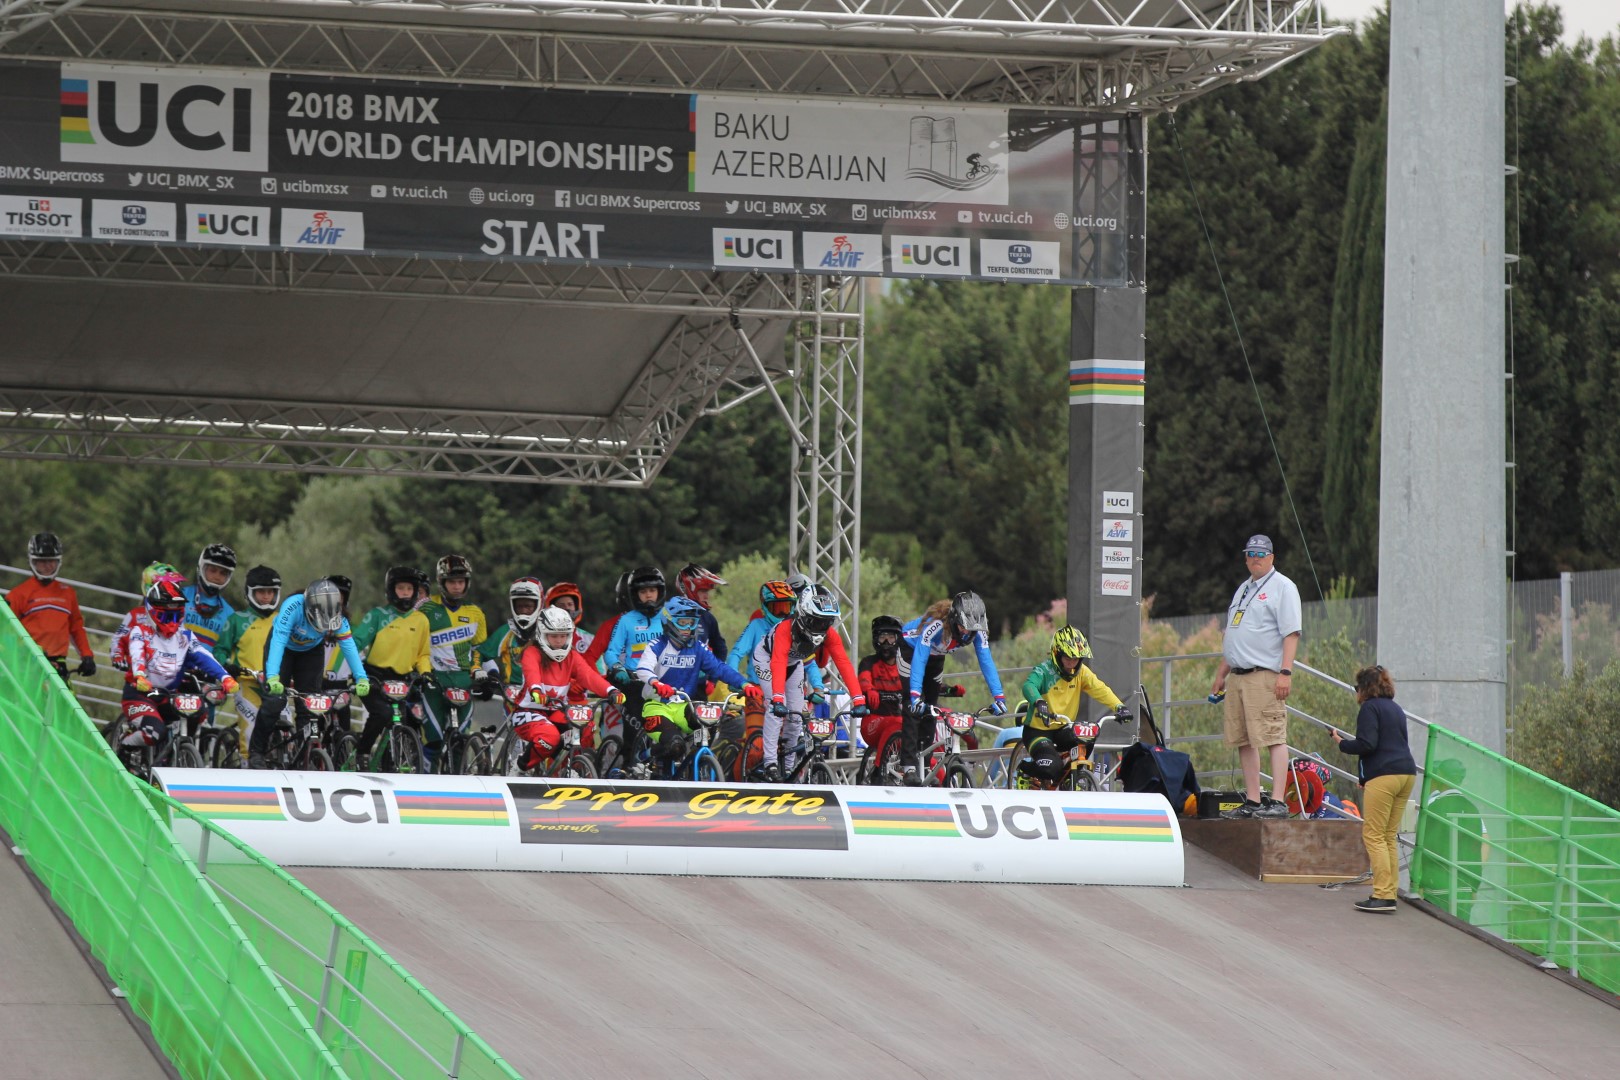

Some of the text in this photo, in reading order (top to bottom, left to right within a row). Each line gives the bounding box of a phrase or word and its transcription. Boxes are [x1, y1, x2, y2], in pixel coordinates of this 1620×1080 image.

[98, 80, 252, 152] UCI
[287, 92, 440, 124] 2018 BMX
[714, 112, 790, 141] BAKU
[286, 128, 674, 173] WORLD CHAMPIONSHIPS
[0, 166, 104, 184] BMX Supercross
[712, 150, 886, 182] AZERBAIJAN
[147, 173, 235, 191] UCI_BMX_SX
[282, 180, 349, 195] ucibmxsx
[392, 185, 448, 200] tv.uci.ch
[488, 190, 535, 207] uci.org
[575, 193, 701, 212] UCI BMX Supercross
[744, 201, 827, 218] UCI_BMX_SX
[6, 212, 72, 227] TISSOT
[873, 206, 937, 220] ucibmxsx
[978, 211, 1033, 224] tv.uci.ch
[209, 214, 258, 236] UCI
[1073, 215, 1117, 231] uci.org
[99, 227, 169, 238] TEKFEN CONSTRUCTION
[480, 219, 605, 259] START
[735, 238, 782, 260] UCI
[912, 244, 960, 267] UCI
[987, 266, 1053, 276] TEKFEN CONSTRUCTION
[1110, 498, 1129, 507] UCI
[431, 627, 474, 646] BRASIL
[662, 655, 697, 668] FINLAND
[179, 699, 197, 710] 283
[310, 699, 326, 710] 276
[701, 707, 717, 719] 279
[281, 786, 390, 824] UCI
[533, 787, 825, 820] Pro Gate
[955, 803, 1060, 840] UCI
